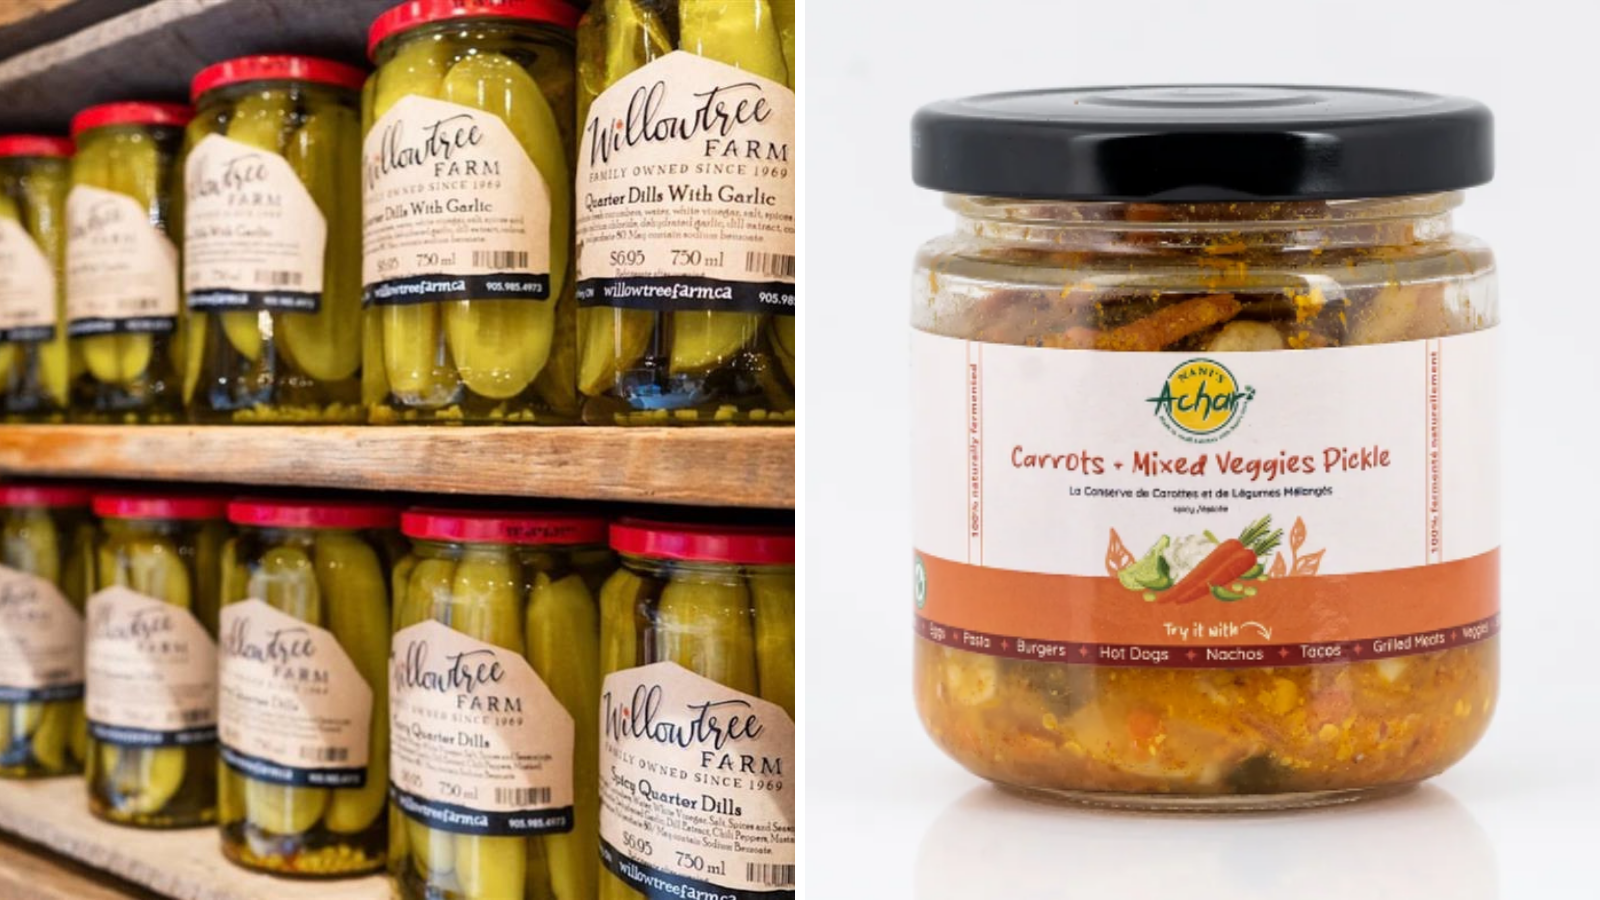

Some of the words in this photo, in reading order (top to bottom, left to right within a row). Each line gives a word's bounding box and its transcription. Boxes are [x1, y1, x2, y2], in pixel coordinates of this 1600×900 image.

[588, 80, 771, 167] Willowtree
[704, 139, 788, 161] FARM
[433, 160, 500, 177] FARM
[632, 164, 689, 176] OWNED
[696, 163, 746, 176] SINCE
[754, 165, 788, 179] 1969
[410, 199, 443, 216] With
[446, 197, 493, 214] Garlic
[585, 192, 626, 212] Quarter
[628, 186, 664, 204] Dills
[668, 184, 712, 202] With
[717, 185, 776, 206] Garlic
[670, 250, 702, 266] 750
[704, 251, 724, 267] ml
[758, 291, 796, 306] 905.98
[969, 363, 979, 434] fermented
[1144, 380, 1247, 421] Achar
[969, 436, 979, 499] naturally
[1011, 444, 1105, 476] Carrots
[1132, 450, 1207, 477] Mixed
[1215, 451, 1316, 482] Veggies
[1323, 445, 1391, 473] Pickle
[1069, 486, 1082, 496] La
[1084, 486, 1132, 499] Conserve
[1136, 487, 1150, 499] de
[1152, 487, 1199, 500] Carottes
[1201, 488, 1212, 499] et
[1215, 488, 1229, 499] de
[1163, 621, 1189, 641] Try
[1192, 621, 1204, 638] it
[1207, 620, 1240, 638] with
[963, 631, 991, 648] Pasta
[1016, 638, 1066, 658] Burgers
[1100, 646, 1126, 659] Hot
[1129, 646, 1169, 662] Dogs
[1206, 646, 1264, 660] Nachos
[1300, 645, 1342, 658] Tacos
[1372, 635, 1412, 653] Grilled
[1414, 633, 1445, 648] Meats
[457, 694, 523, 712] FARM
[603, 684, 763, 750] Willowtree
[411, 722, 455, 746] Quarter
[457, 731, 490, 749] Dills
[638, 759, 688, 780] OWNED
[694, 772, 742, 789] SINCE
[749, 780, 783, 791] 1969
[701, 750, 783, 776] FARM
[638, 779, 698, 810] Quarter
[701, 794, 742, 816] Dills
[675, 850, 705, 871] 750
[706, 860, 727, 876] ml
